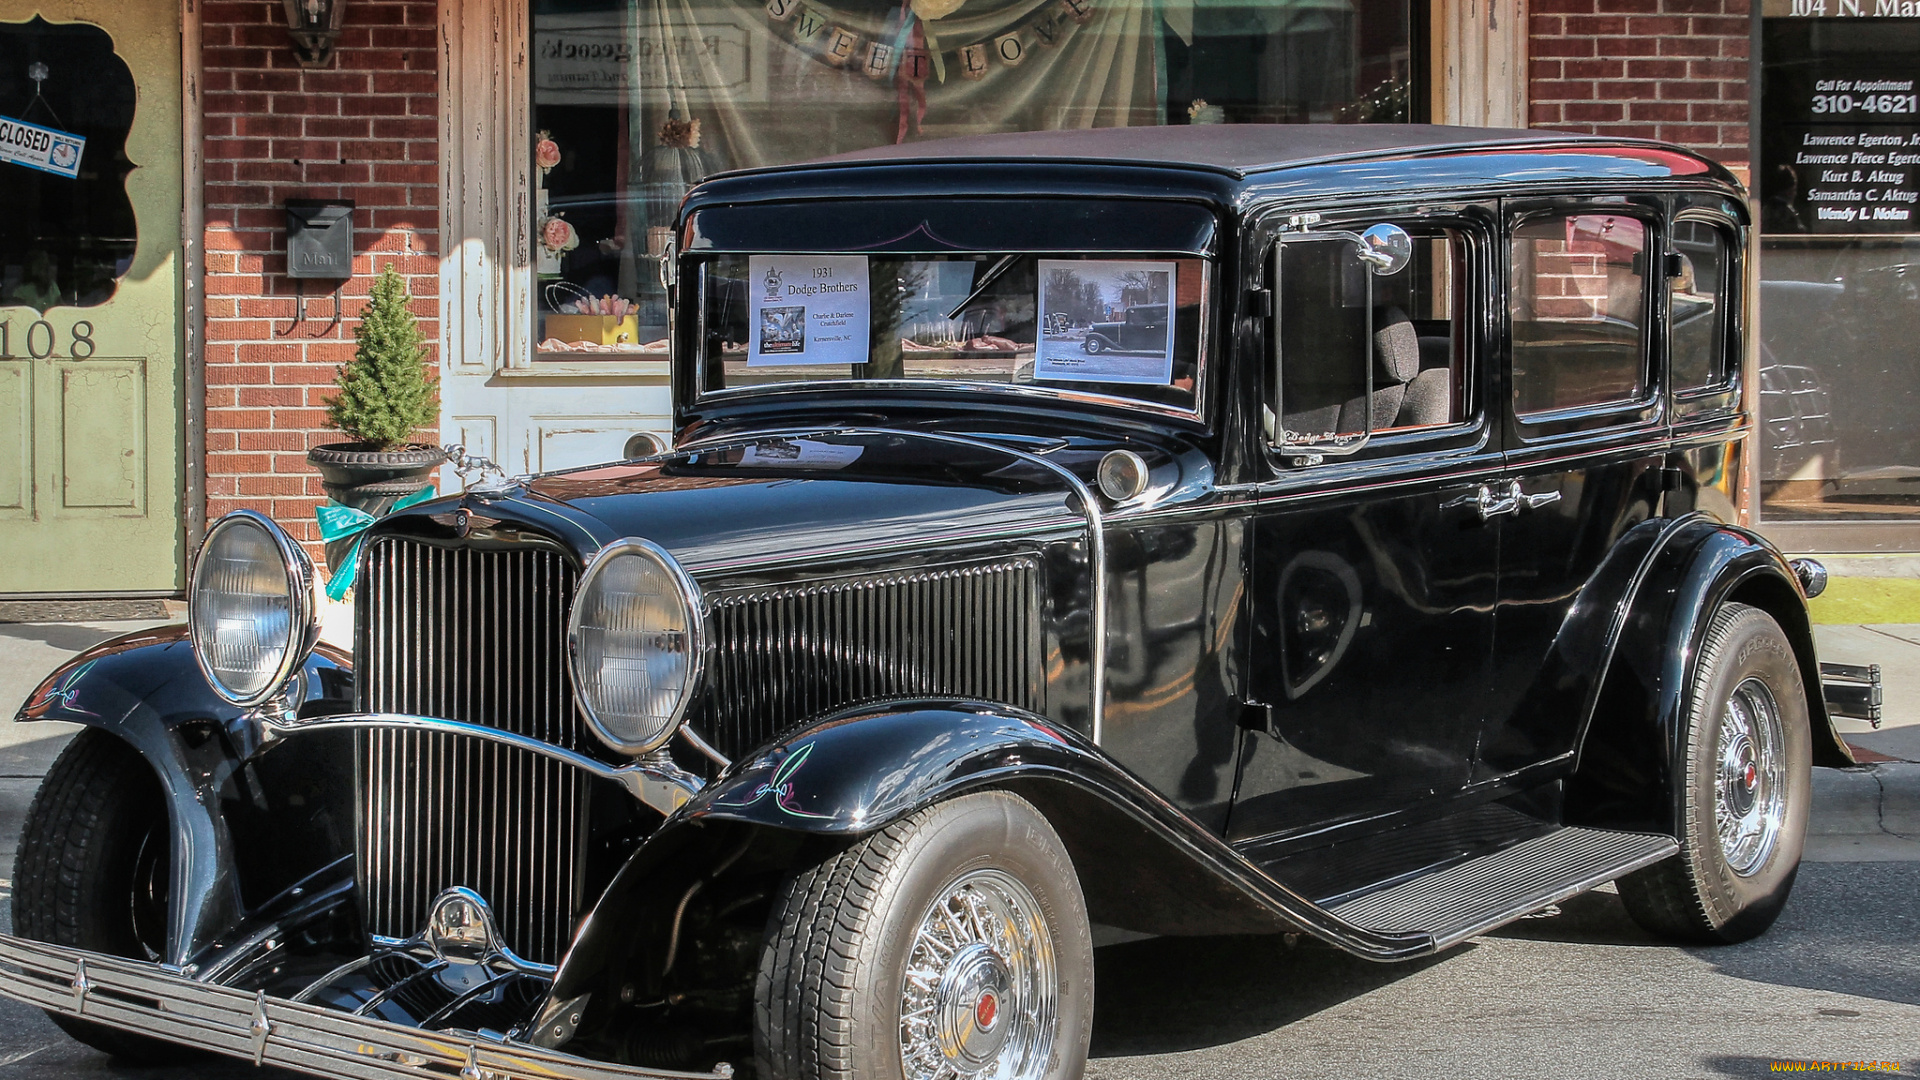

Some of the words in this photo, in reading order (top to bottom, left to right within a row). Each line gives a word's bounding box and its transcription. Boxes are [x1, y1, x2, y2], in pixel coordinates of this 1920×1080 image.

[1789, 0, 1827, 17] 104
[1815, 80, 1836, 91] Call
[1836, 80, 1852, 91] For
[1853, 80, 1914, 93] Appointment
[1811, 94, 1918, 113] 310-4621
[0, 122, 50, 152] CLOSED
[1803, 133, 1856, 146] Lawrence
[1796, 152, 1849, 164] Lawrence
[1850, 152, 1886, 164] Pierce
[1821, 170, 1849, 182] Kurt
[1851, 170, 1864, 182] B.
[1866, 170, 1906, 185] Aktug
[1807, 188, 1863, 201] Samantha
[1865, 188, 1879, 201] C.
[1881, 188, 1919, 203] Aktug
[1817, 207, 1858, 222] Wendy
[1872, 207, 1910, 220] Nolan
[303, 252, 338, 265] Mail
[812, 267, 833, 279] 1931
[788, 285, 817, 296] Dodge
[820, 282, 858, 294] Brothers
[0, 320, 96, 359] 108
